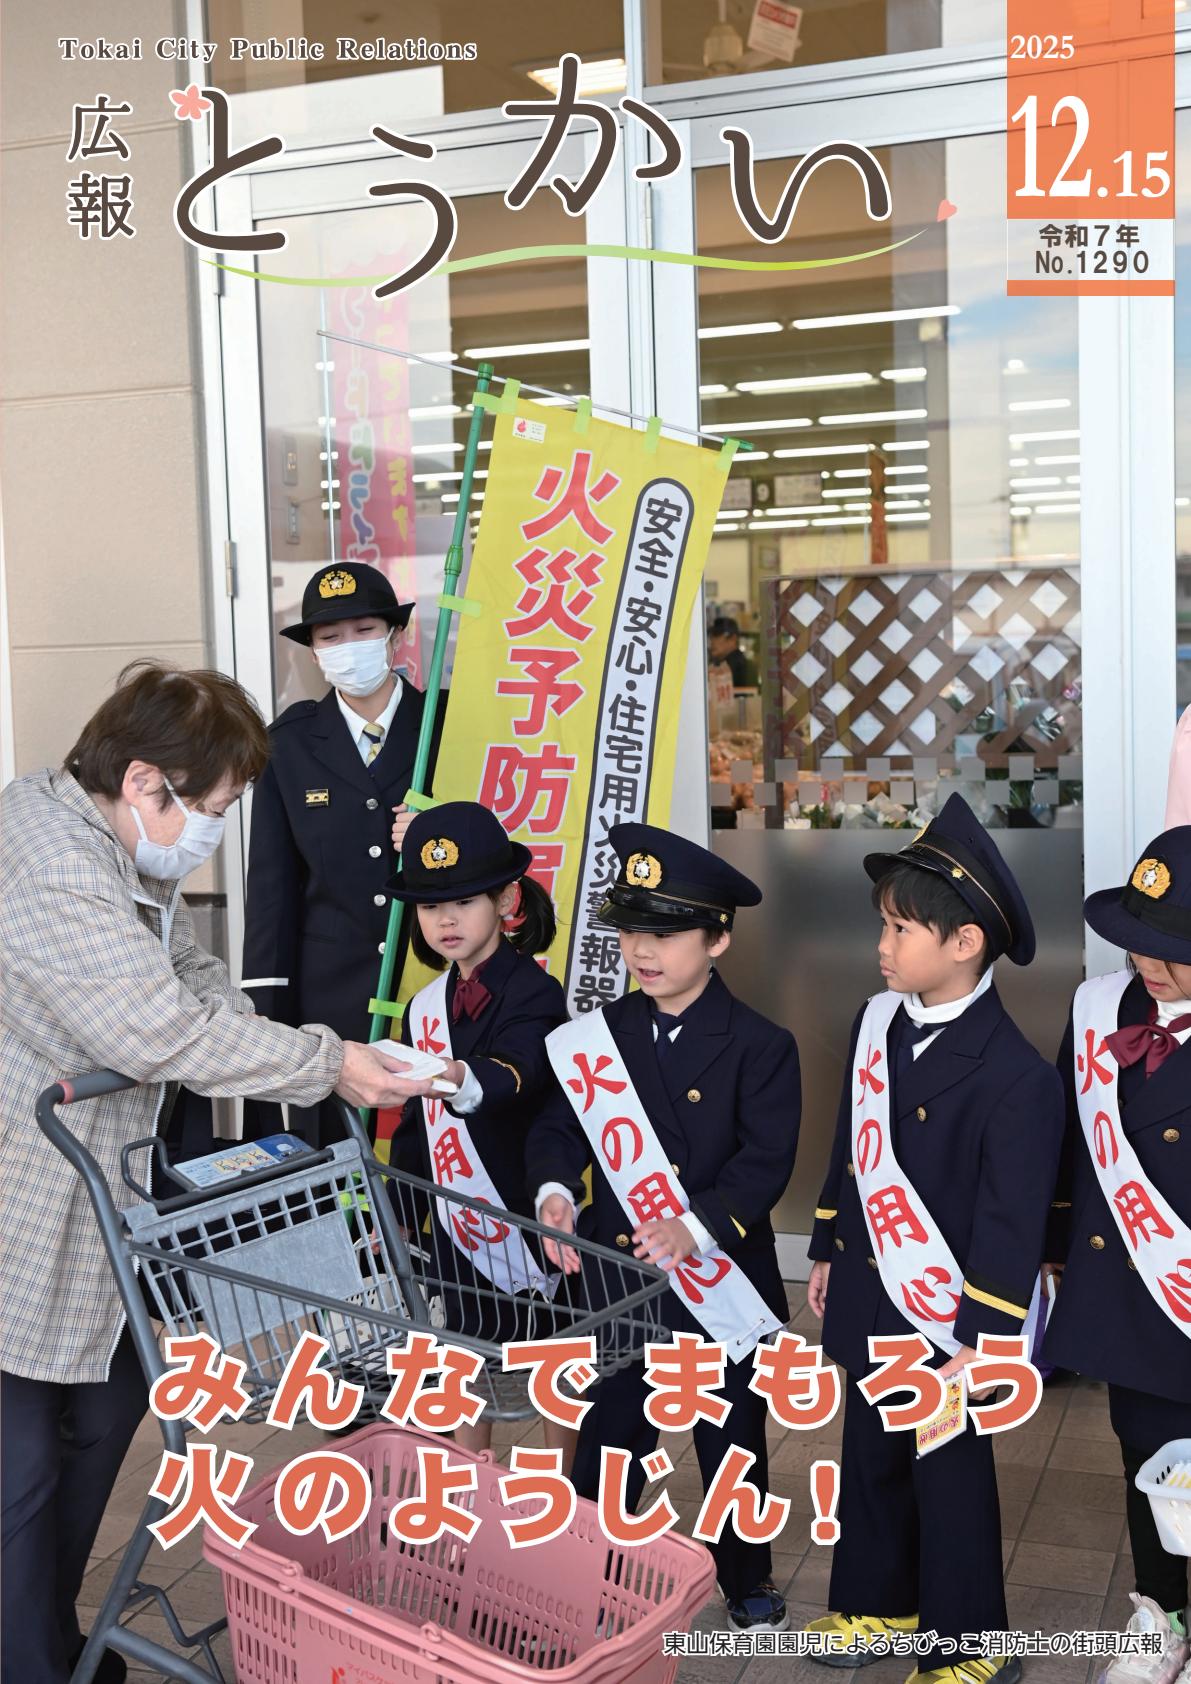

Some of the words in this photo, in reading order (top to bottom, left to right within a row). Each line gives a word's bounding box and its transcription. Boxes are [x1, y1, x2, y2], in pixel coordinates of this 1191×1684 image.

[478, 450, 622, 937] 火災予防
[857, 1043, 963, 1324] 火の用心
